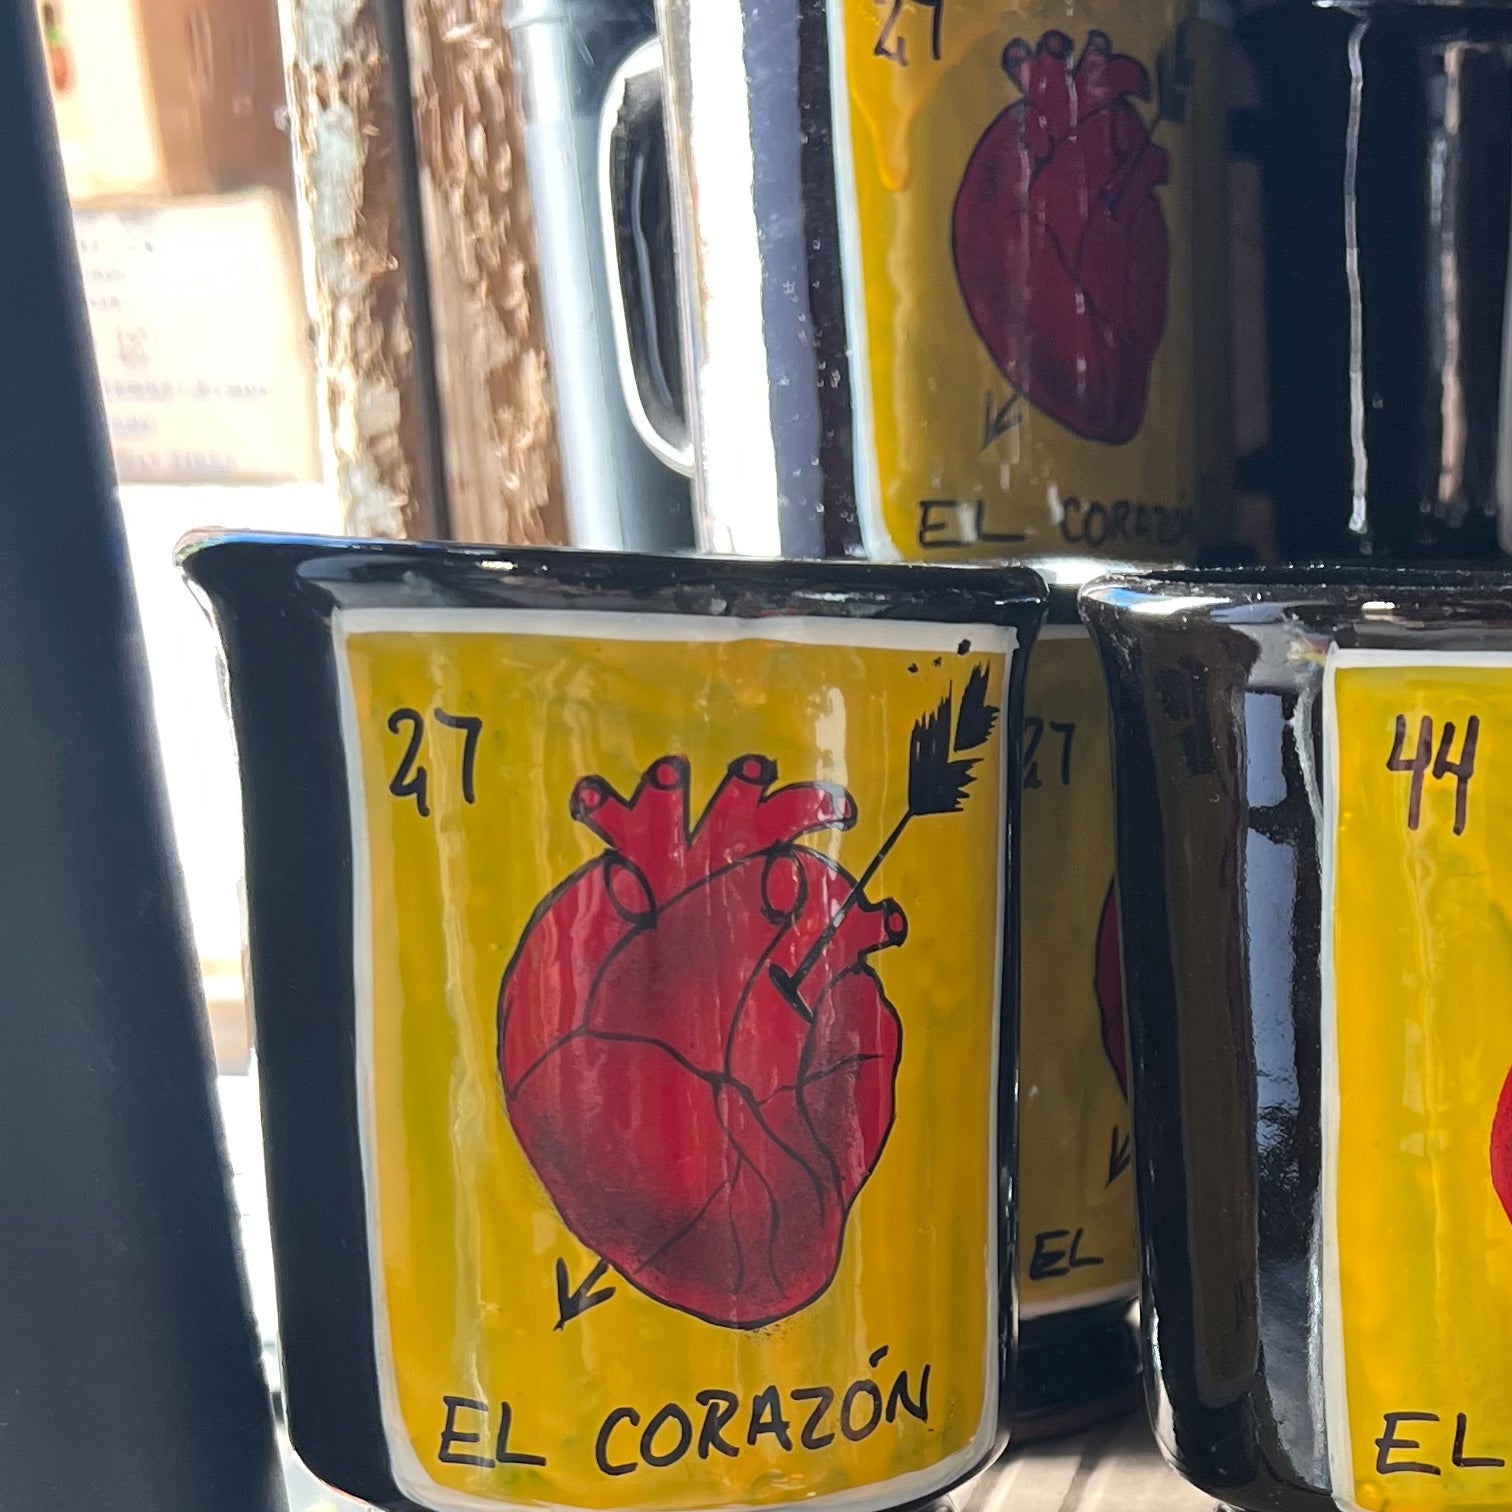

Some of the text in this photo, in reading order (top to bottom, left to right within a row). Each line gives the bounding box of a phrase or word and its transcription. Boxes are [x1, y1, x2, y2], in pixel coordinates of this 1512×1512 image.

[919, 499, 1025, 547] EL
[388, 708, 482, 816] 27
[1023, 716, 1076, 790] 27
[1386, 714, 1480, 835] 44
[1029, 1226, 1105, 1281] EL
[437, 1345, 932, 1475] EL CORAZÓN
[1374, 1411, 1505, 1476] EL
